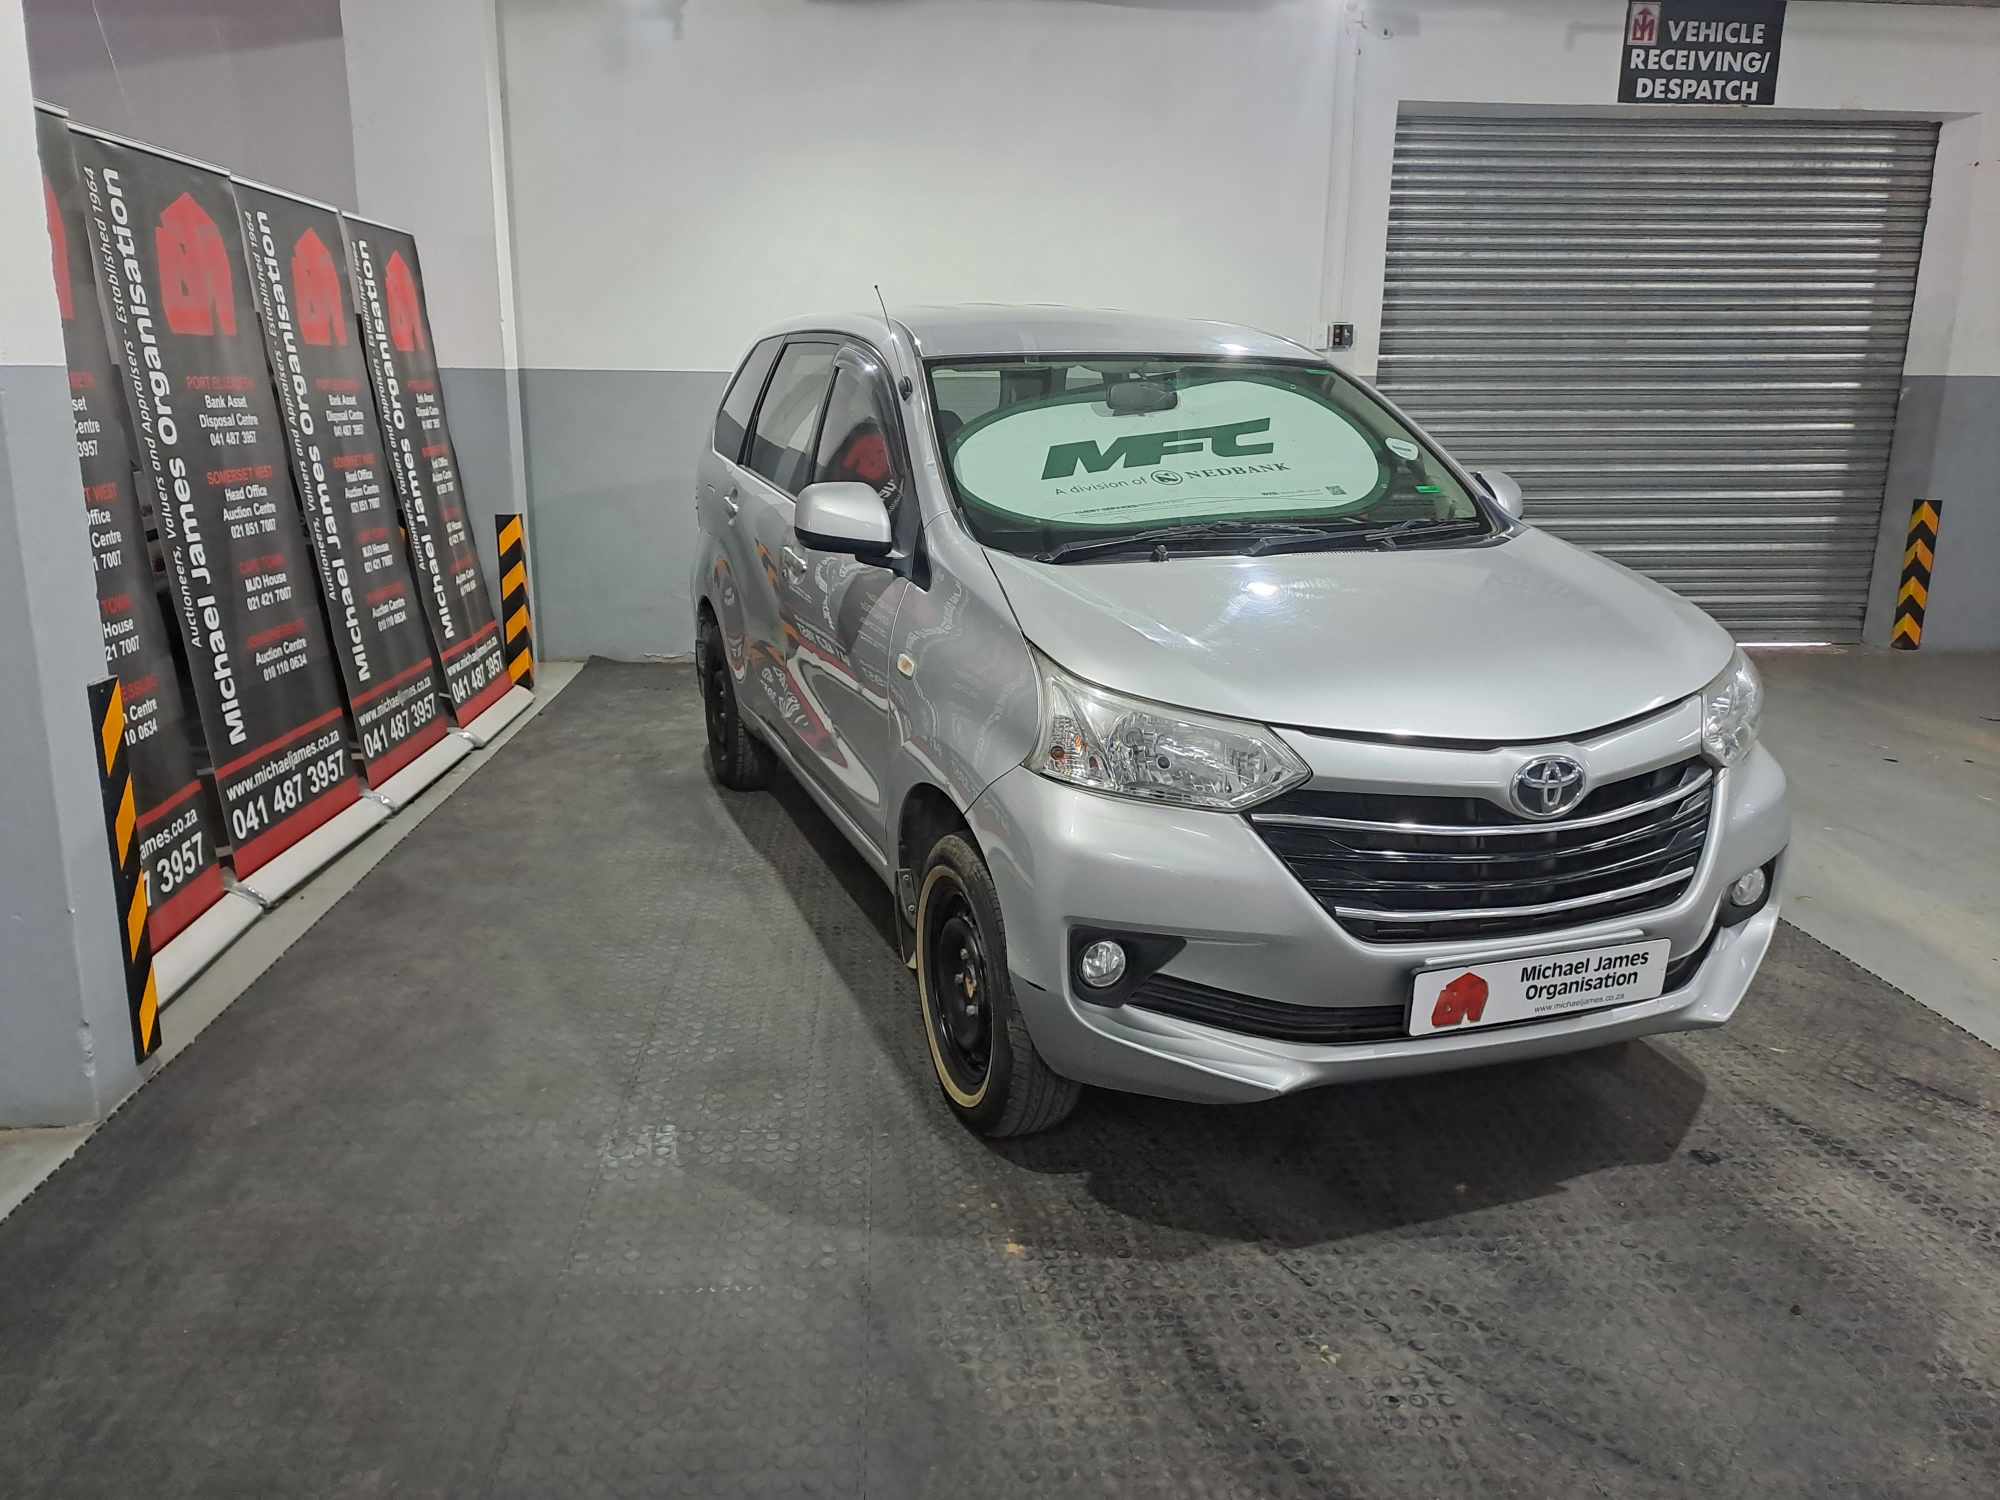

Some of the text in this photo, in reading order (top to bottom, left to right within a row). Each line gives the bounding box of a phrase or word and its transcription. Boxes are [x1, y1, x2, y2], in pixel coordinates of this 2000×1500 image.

[1668, 20, 1765, 44] VEHICLE
[1630, 48, 1771, 73] RECEIVING/
[1636, 78, 1759, 101] DESPATCH
[83, 165, 103, 214] 1964
[94, 217, 128, 324] Established
[358, 240, 405, 430] Organisation
[124, 340, 153, 434] Appraisers
[205, 395, 226, 409] Bank
[72, 396, 87, 411] set
[199, 413, 235, 430] Disposal
[385, 424, 397, 449] and
[143, 436, 161, 472] and
[210, 432, 225, 447] 041
[226, 431, 240, 445] 487
[256, 211, 371, 682] Michael James Organisation
[290, 428, 304, 457] and
[1041, 417, 1274, 480] MFC
[102, 167, 247, 746] Michael James Organisation
[246, 484, 267, 499] Office
[400, 438, 428, 527] James
[1055, 462, 1292, 495] A division of NEDBANK
[155, 476, 176, 539] Valuers
[223, 507, 252, 521] Auction
[91, 530, 122, 549] Centre
[230, 523, 245, 539] 021
[100, 549, 122, 569] 7007
[263, 573, 287, 588] House
[420, 534, 455, 640] Michael
[172, 545, 202, 648] Auctioneers,
[246, 597, 261, 612] 021
[102, 618, 134, 639] House
[105, 635, 140, 662] 21 7007
[255, 647, 283, 666] Auction
[452, 649, 503, 704] 041 487 3957
[129, 698, 158, 721] Centre
[124, 731, 137, 747] 10
[138, 717, 158, 741] 0634
[363, 692, 436, 758] 041 487 3957
[226, 730, 340, 802] www.michaeljames.co.za
[232, 795, 269, 840] 041
[273, 773, 303, 813] 487
[307, 748, 345, 794] 3957
[156, 831, 204, 894] 3957
[1520, 950, 1650, 983] Michael James
[1525, 970, 1639, 1001] Organisation
